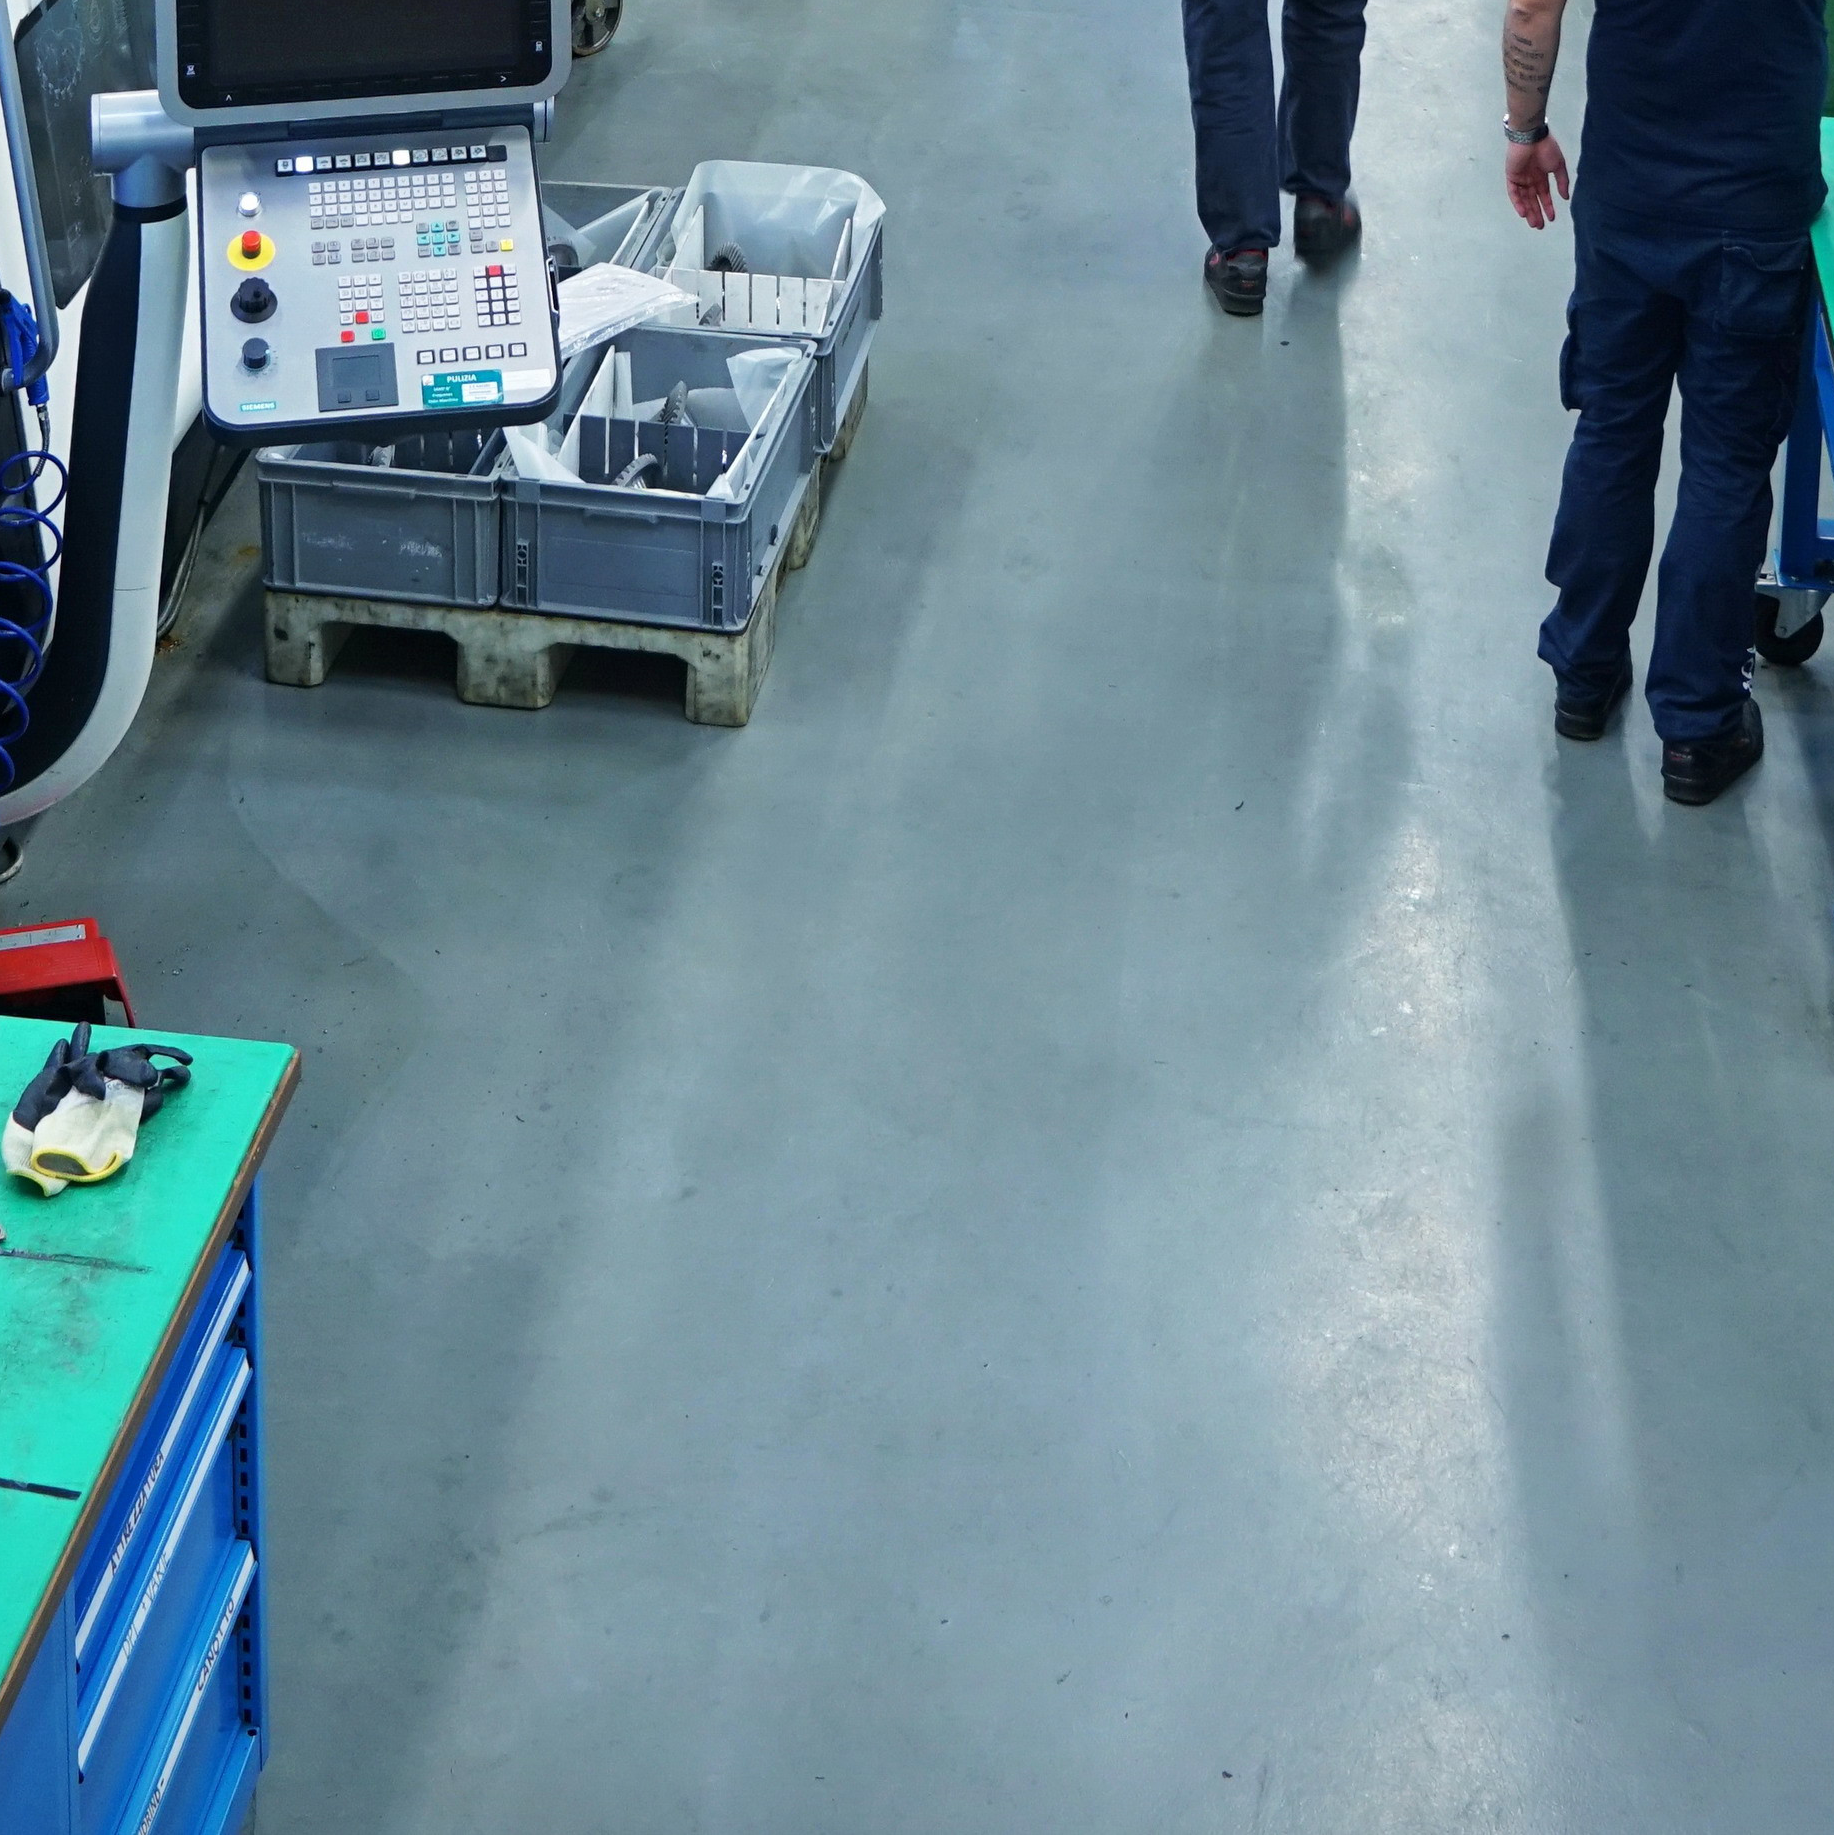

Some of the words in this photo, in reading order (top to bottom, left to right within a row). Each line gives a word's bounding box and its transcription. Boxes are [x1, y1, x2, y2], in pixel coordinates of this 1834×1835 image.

[447, 374, 477, 383] PULIZIA
[241, 402, 276, 411] SIEMENS
[197, 1598, 235, 1692] CANOTTO
